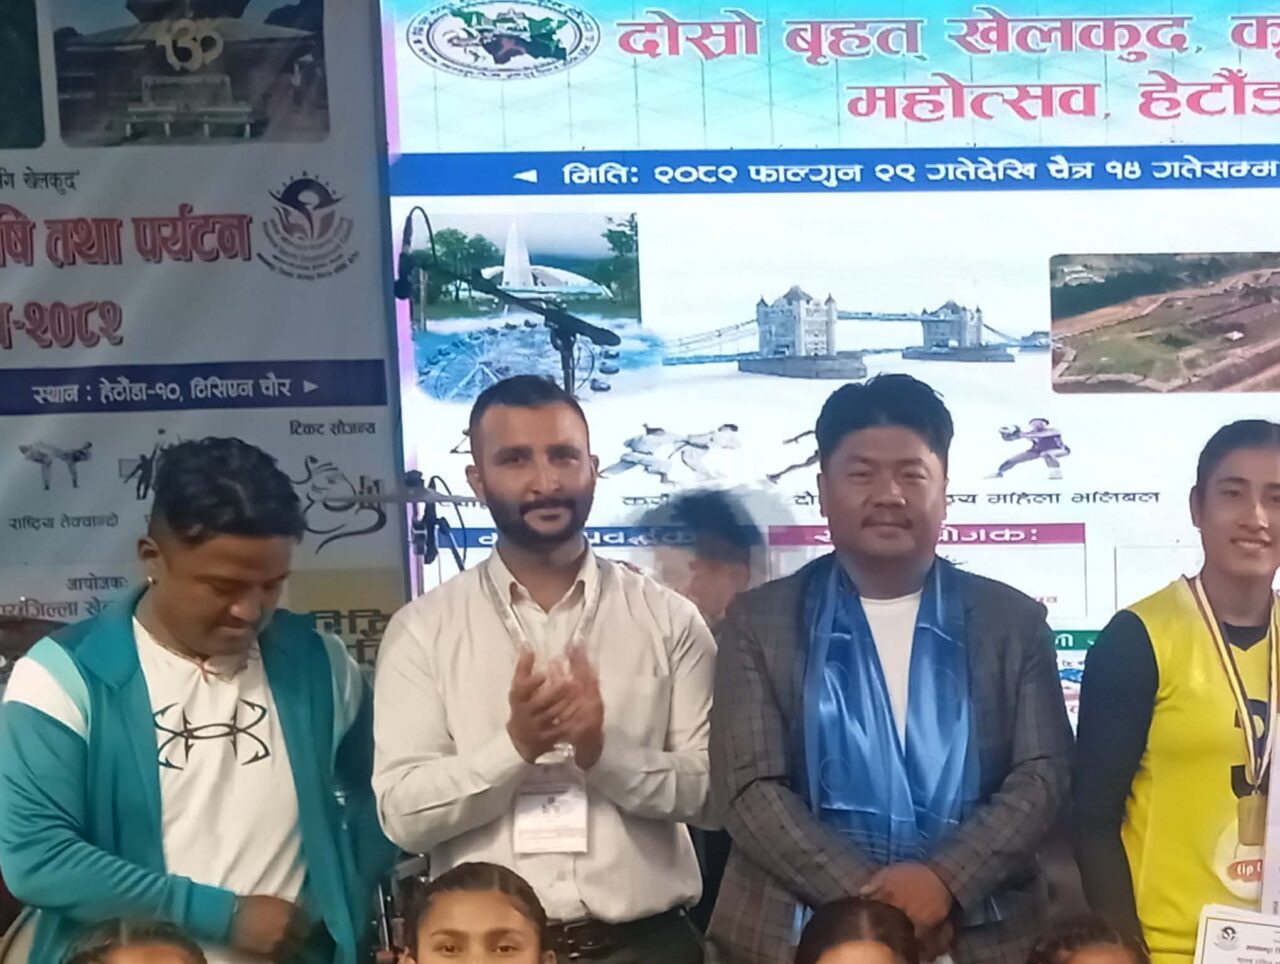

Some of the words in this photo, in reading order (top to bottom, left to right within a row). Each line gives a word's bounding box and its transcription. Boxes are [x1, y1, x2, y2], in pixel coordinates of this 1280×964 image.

[617, 9, 761, 60] दोस्रो
[786, 16, 927, 63] बृहत्
[655, 165, 737, 184] २०८२
[748, 164, 863, 187] फाल्गुन
[925, 155, 1037, 181] गतेदेखि
[1047, 155, 1094, 180] चैत्र
[1152, 156, 1280, 180] गतेसम्म
[44, 216, 124, 270] तथा
[131, 203, 256, 265] पर्यटन
[32, 383, 79, 405] स्थान
[259, 371, 291, 397] चौर
[289, 419, 325, 436] टिकट
